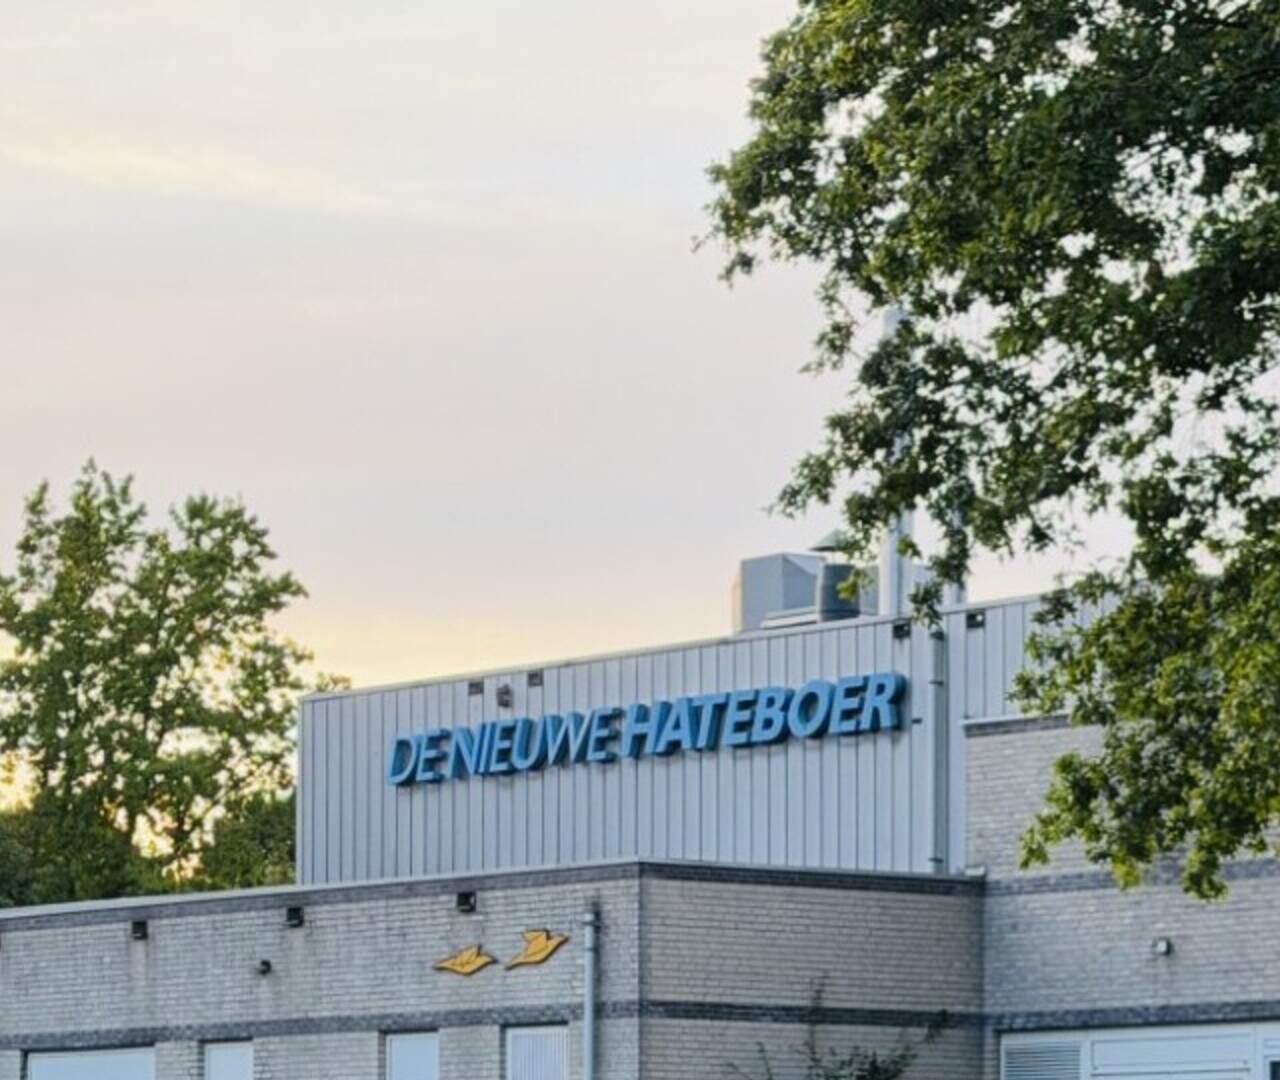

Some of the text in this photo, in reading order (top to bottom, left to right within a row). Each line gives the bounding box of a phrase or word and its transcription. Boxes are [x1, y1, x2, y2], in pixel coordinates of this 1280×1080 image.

[387, 671, 907, 786] DE NIEUWE HATEBOER
